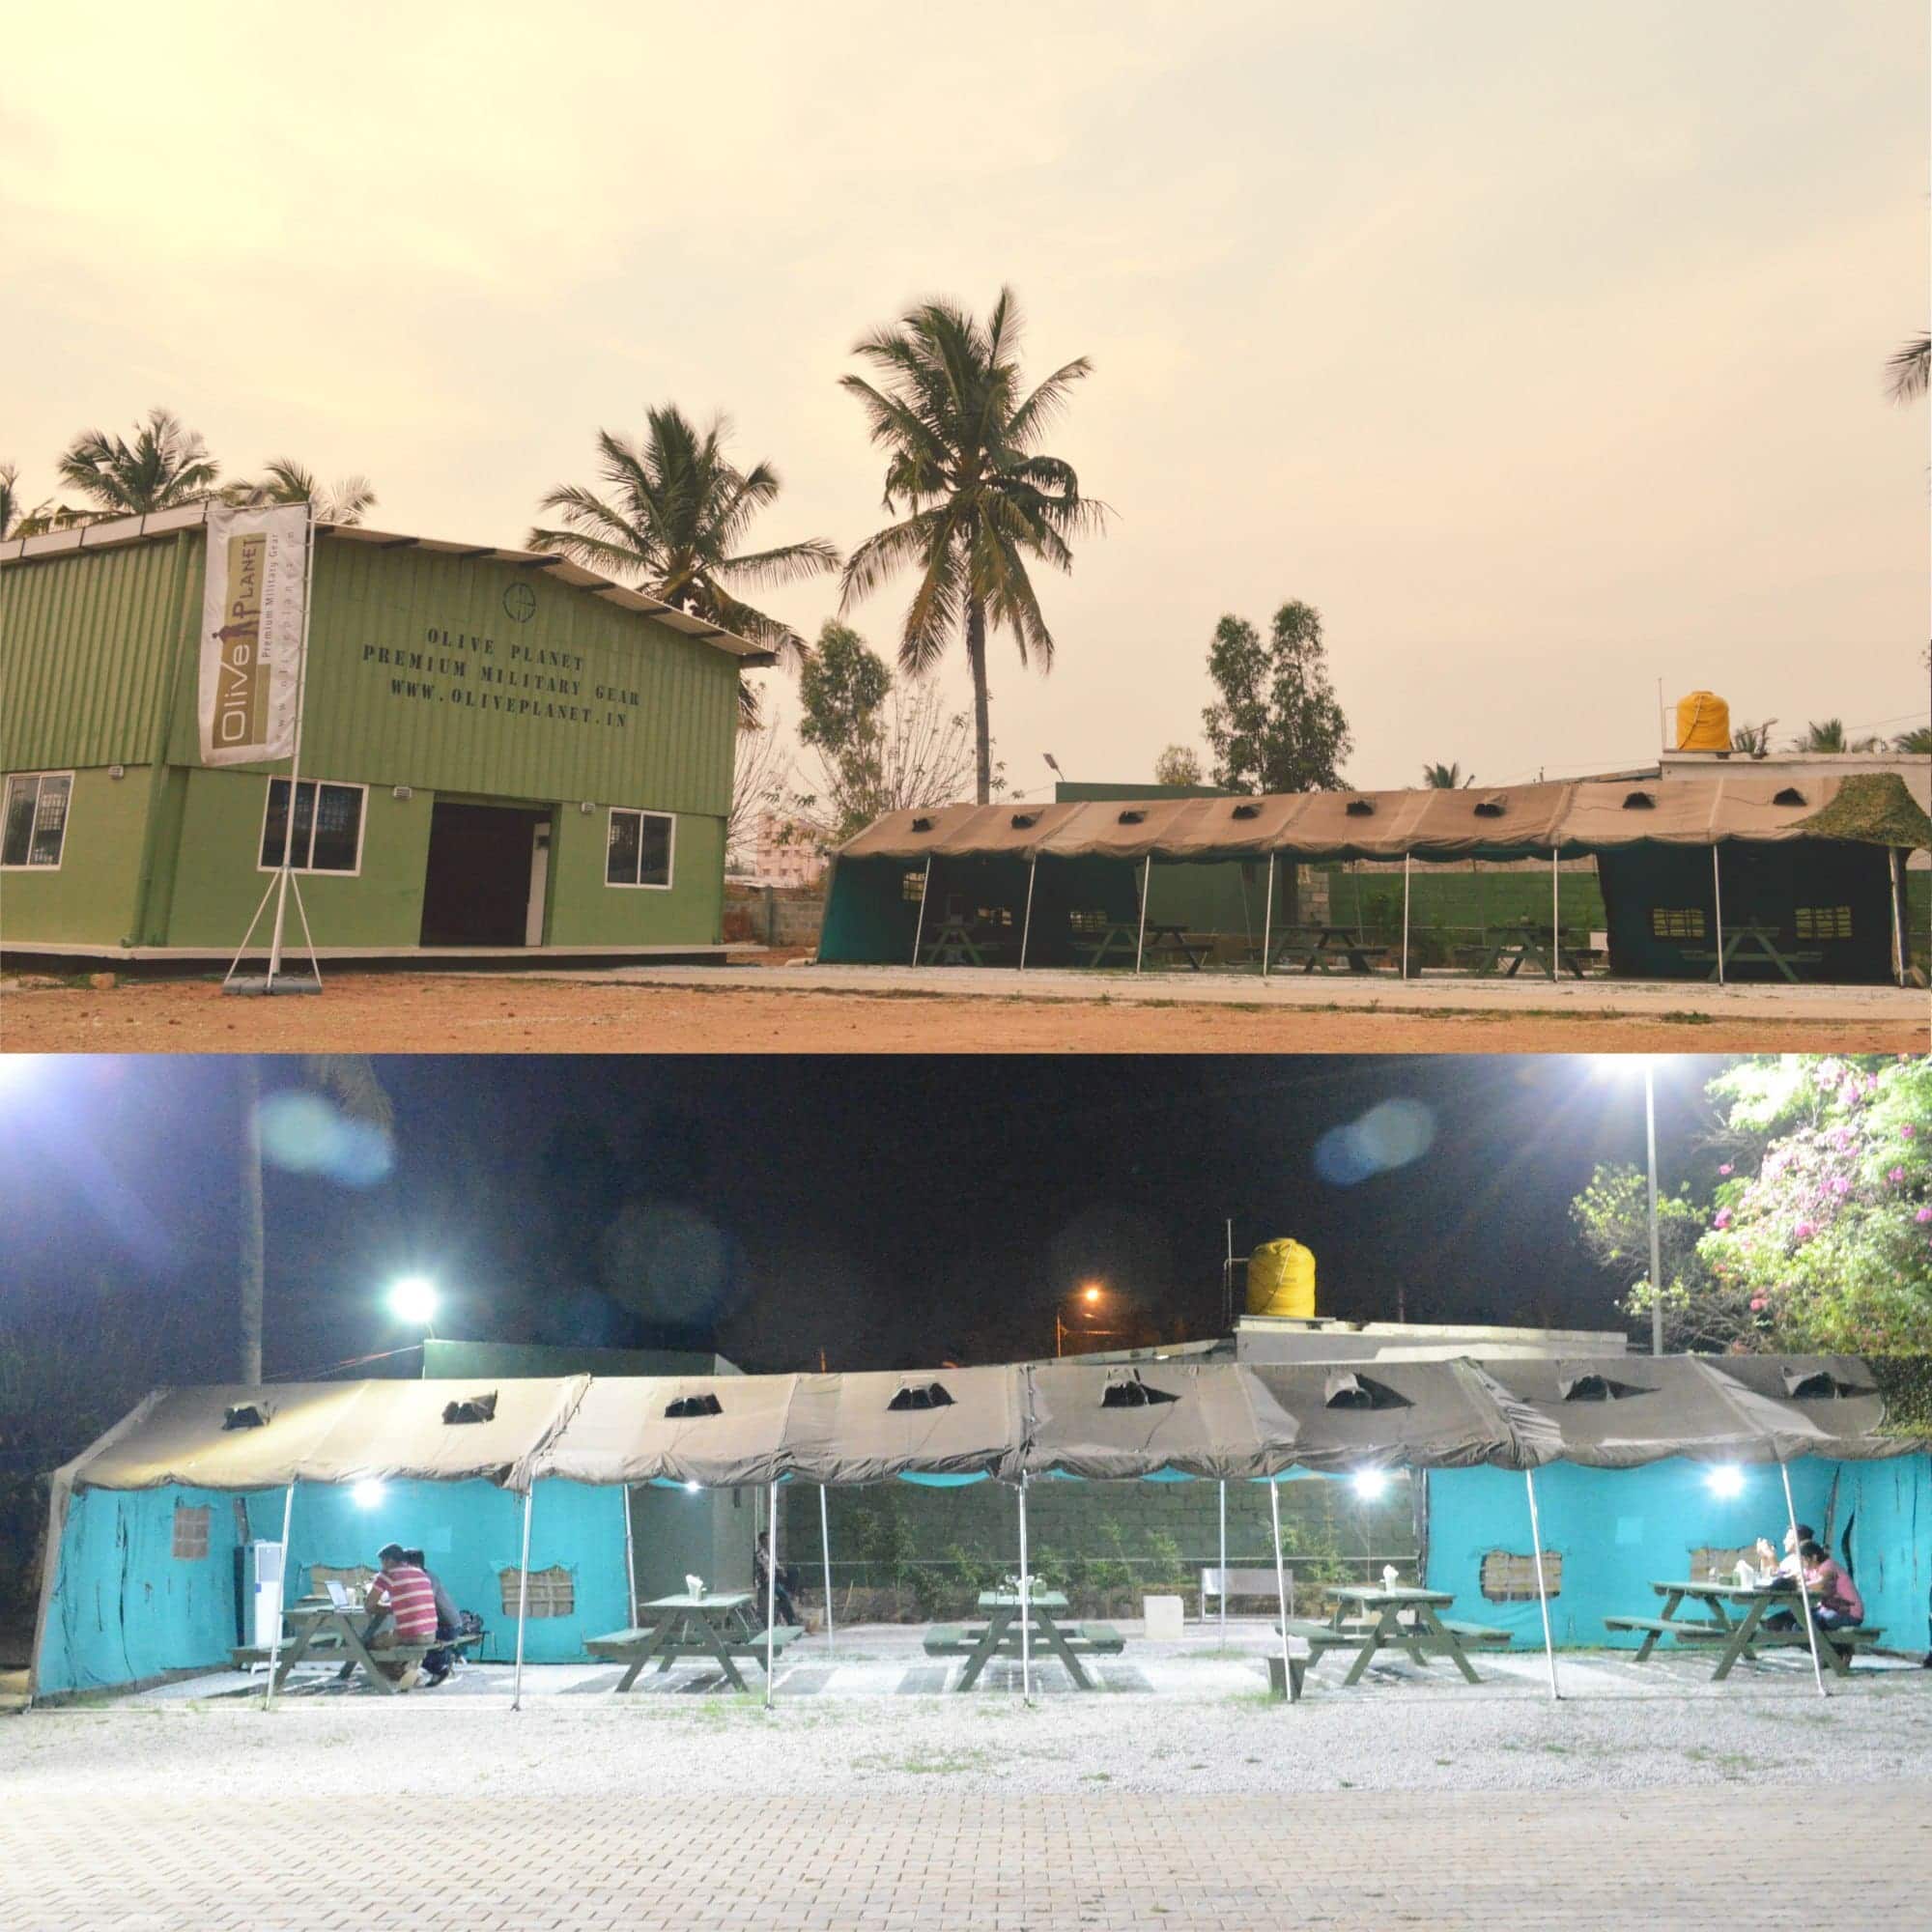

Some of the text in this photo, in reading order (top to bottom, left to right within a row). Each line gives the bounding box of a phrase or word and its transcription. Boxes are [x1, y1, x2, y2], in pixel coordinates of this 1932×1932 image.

[262, 533, 279, 658] Premium Military Gear
[363, 644, 640, 706] PREMIUM MILITARY GEAR
[428, 628, 584, 671] OLIVE PLANET
[219, 643, 250, 742] Olive
[391, 679, 628, 727] WWW.OLIVEPLANET.IN
